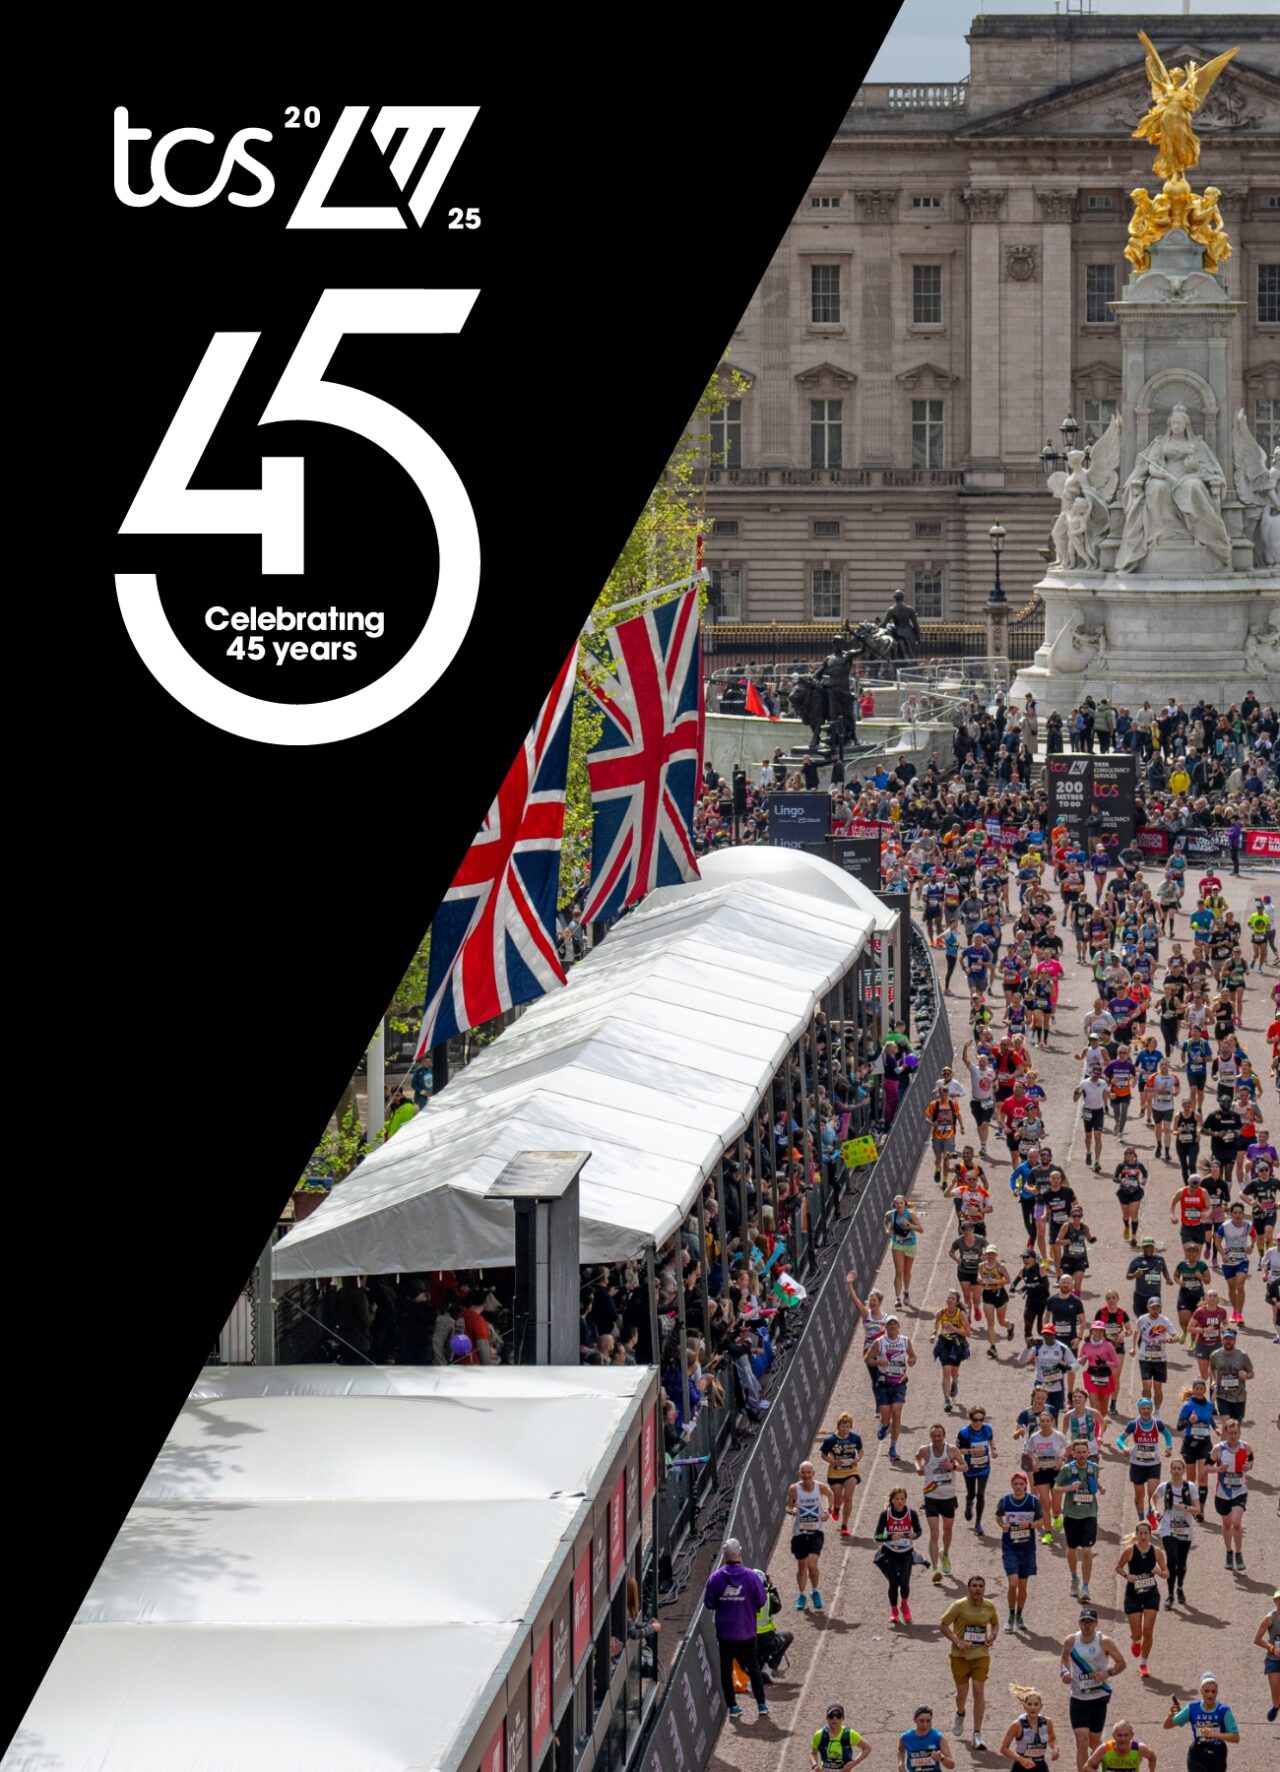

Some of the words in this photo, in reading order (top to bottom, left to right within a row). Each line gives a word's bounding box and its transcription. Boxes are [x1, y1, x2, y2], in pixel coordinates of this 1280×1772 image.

[1051, 761, 1068, 772] tcs
[1056, 781, 1083, 793] 200
[1093, 781, 1119, 798] tcs
[774, 805, 805, 817] Lingo
